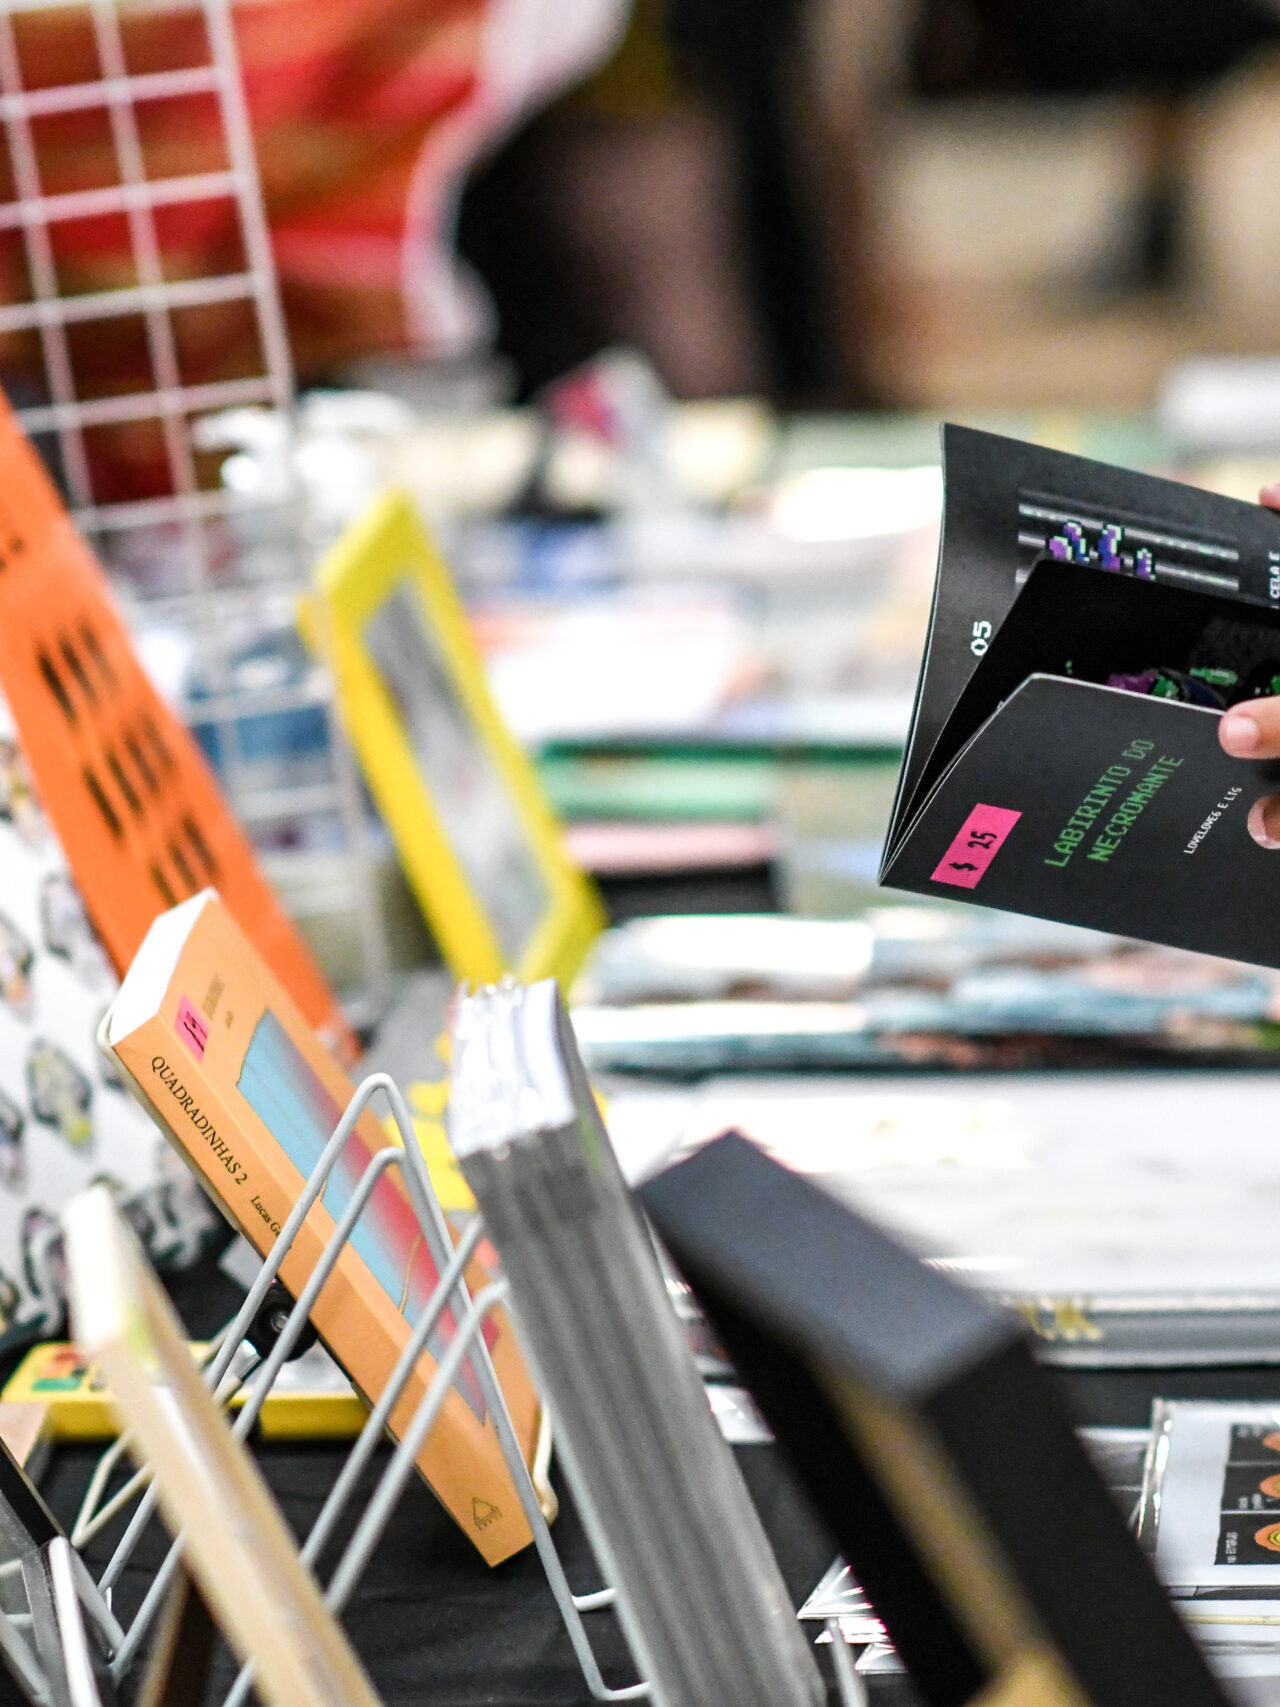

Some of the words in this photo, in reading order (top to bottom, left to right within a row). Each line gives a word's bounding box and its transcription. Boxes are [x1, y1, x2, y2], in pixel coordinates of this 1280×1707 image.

[1269, 565, 1280, 599] CELA
[970, 620, 992, 657] 05
[1044, 764, 1132, 868] LABIRINTO
[1121, 738, 1155, 760] DO
[1086, 755, 1184, 863] NECROMANTE
[1217, 802, 1229, 810] E
[967, 830, 998, 850] 25
[151, 1055, 242, 1175] QUADRADINHAS
[234, 1172, 248, 1186] 2
[250, 1195, 272, 1224] Lucas
